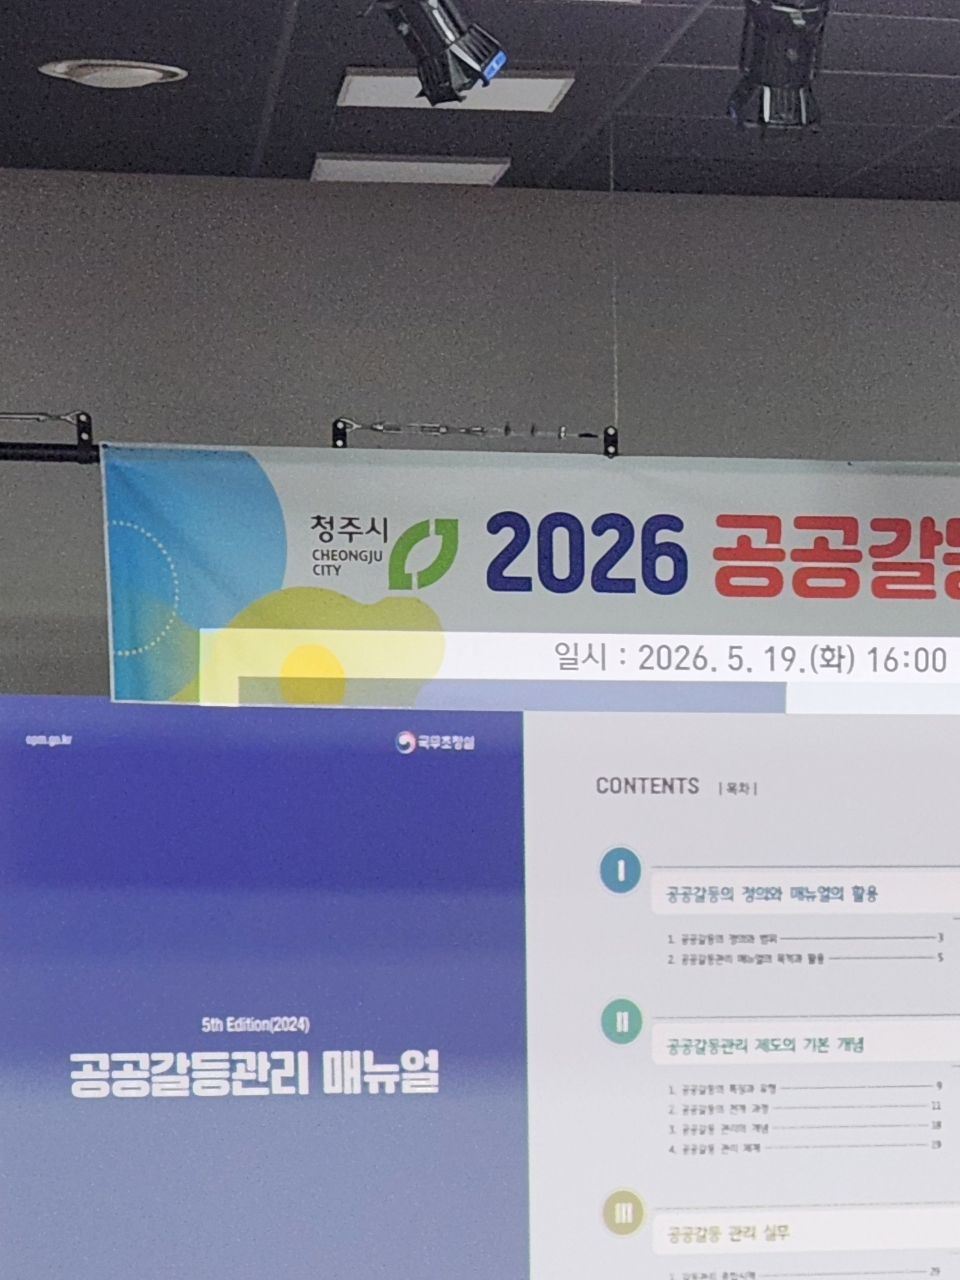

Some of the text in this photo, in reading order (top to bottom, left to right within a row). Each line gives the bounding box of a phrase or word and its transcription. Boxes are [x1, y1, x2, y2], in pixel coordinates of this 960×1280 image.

[310, 515, 388, 543] 청주시
[312, 549, 383, 565] CHEONGJU
[486, 511, 688, 594] 2026
[313, 564, 341, 576] CITY
[554, 643, 607, 670] 일시
[638, 644, 717, 672] 2026.
[727, 646, 753, 673] 5.
[867, 646, 947, 673] 16:00
[596, 777, 700, 794] CONTENTS
[201, 1016, 311, 1034] 5th Edition(2024)
[803, 1037, 830, 1053] 기본
[69, 1048, 440, 1098] 공공갈등관리 매뉴얼
[728, 1225, 756, 1242] 관리
